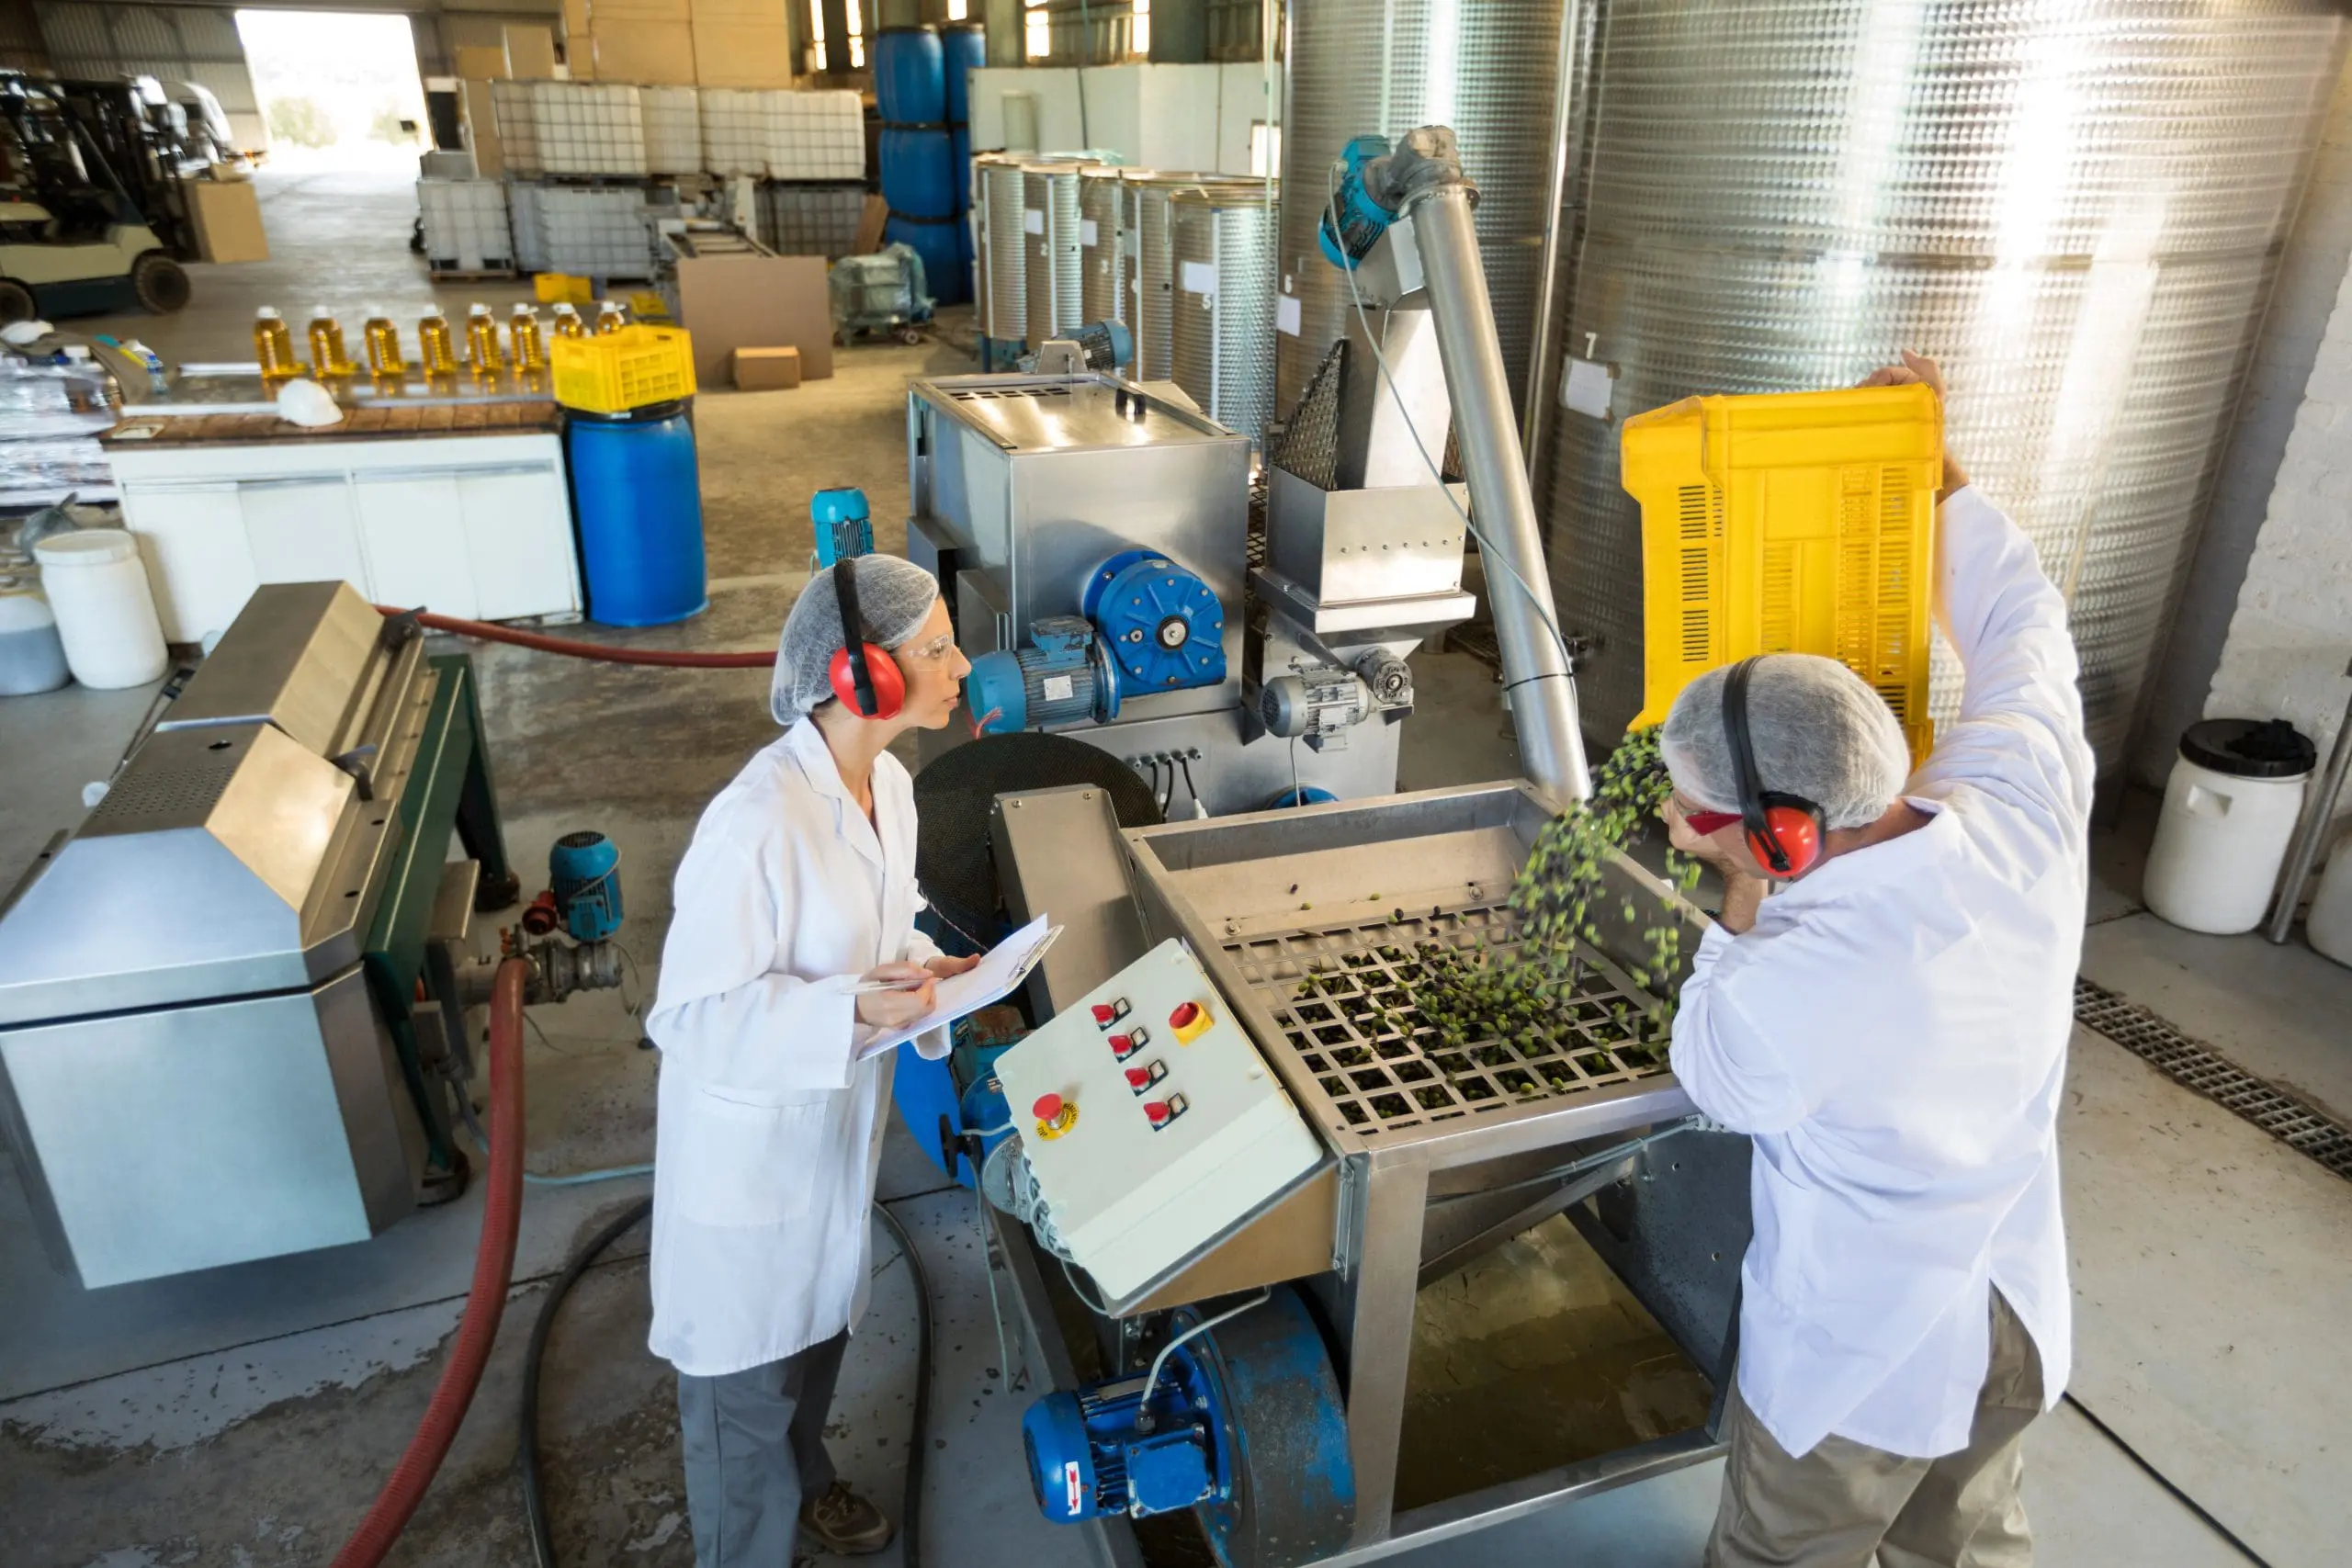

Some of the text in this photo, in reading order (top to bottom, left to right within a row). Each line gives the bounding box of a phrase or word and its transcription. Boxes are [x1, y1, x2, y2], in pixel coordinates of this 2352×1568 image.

[1040, 243, 1048, 256] 2
[1202, 294, 1212, 310] 5
[1585, 332, 1597, 360] 7
